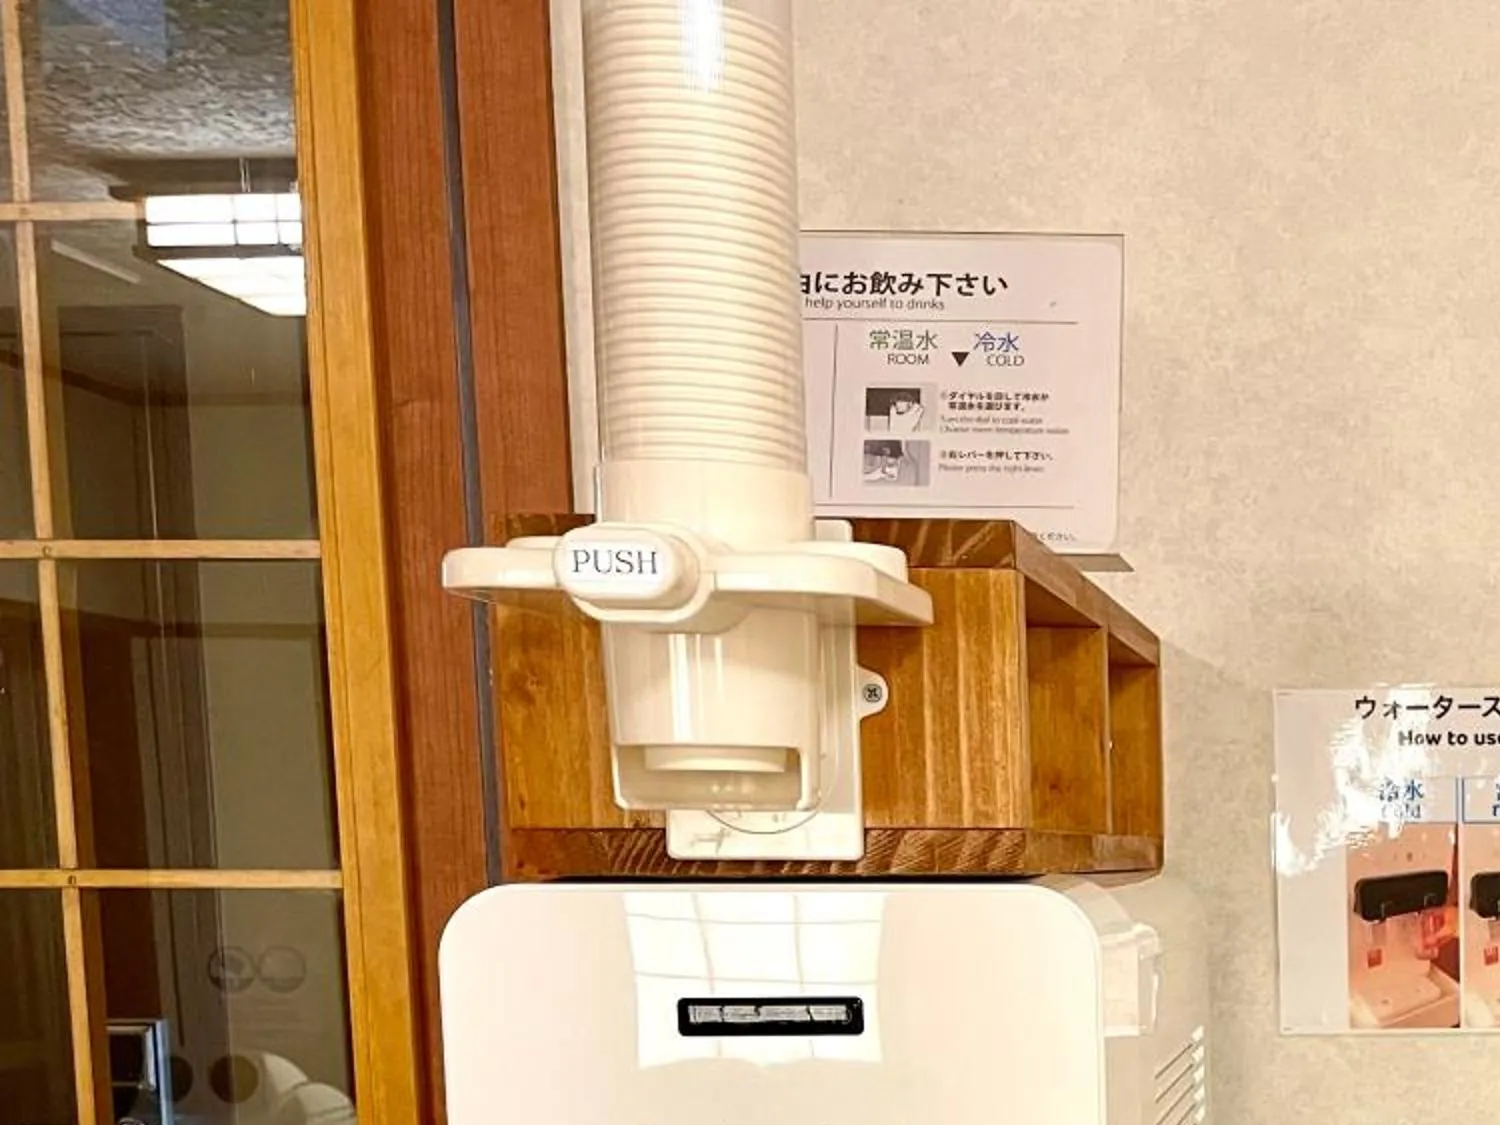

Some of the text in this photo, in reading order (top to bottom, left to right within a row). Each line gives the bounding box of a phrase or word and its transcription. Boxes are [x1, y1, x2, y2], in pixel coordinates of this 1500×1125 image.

[805, 298, 833, 310] help
[837, 298, 886, 311] yourself
[907, 299, 945, 311] drinks
[869, 329, 1021, 351] 常温水 冷水
[887, 354, 1025, 367] ROOM COLD
[571, 549, 658, 575] PUSH
[1398, 731, 1442, 746] How
[1448, 732, 1468, 745] to
